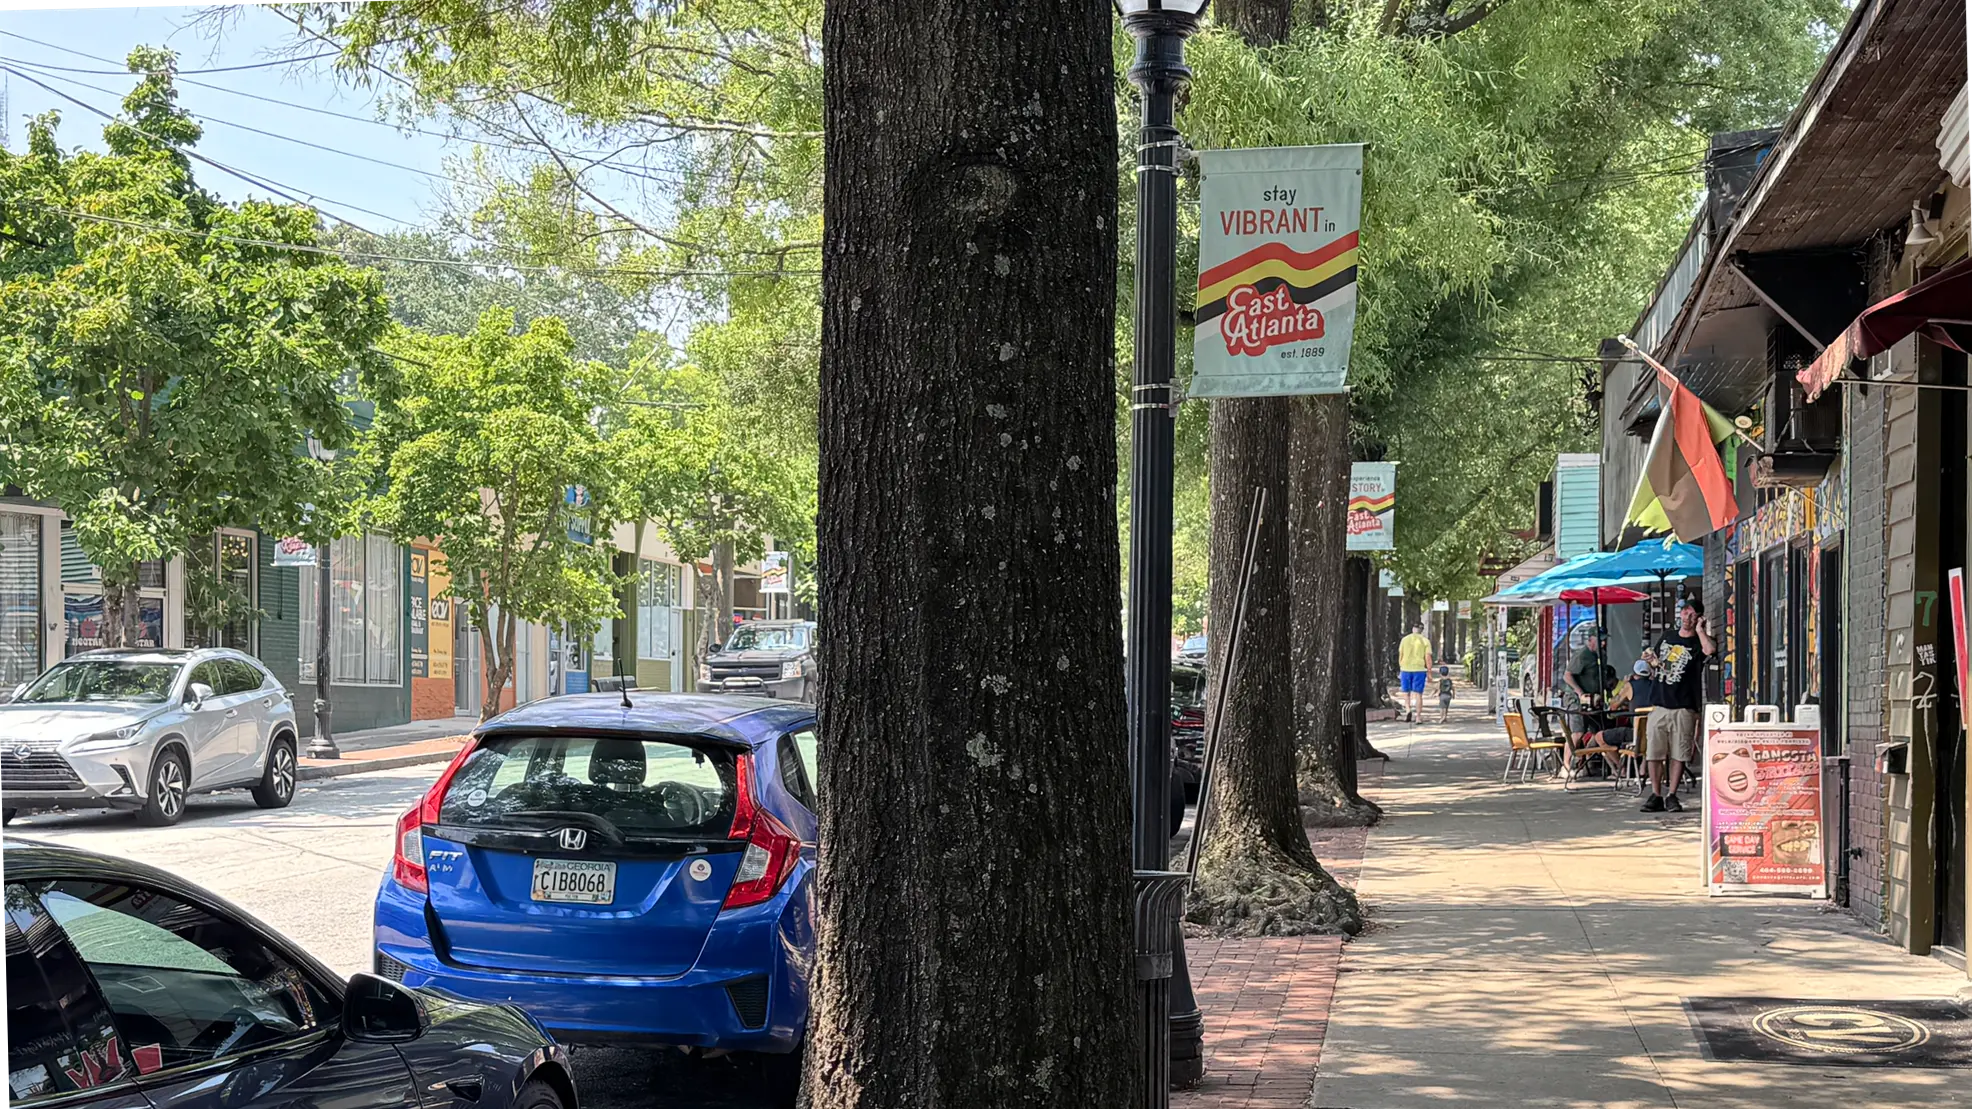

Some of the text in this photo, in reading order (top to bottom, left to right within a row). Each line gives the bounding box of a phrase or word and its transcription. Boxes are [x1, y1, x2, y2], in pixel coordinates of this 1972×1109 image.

[1263, 185, 1297, 206] stay
[1220, 207, 1336, 236] VIBRANT in
[1229, 287, 1289, 318] East
[1223, 307, 1319, 347] Atlanta
[1280, 347, 1325, 359] est. 1889
[1915, 591, 1938, 627] 7
[429, 850, 463, 861] FIT
[566, 861, 611, 872] GEORGIA
[540, 870, 605, 893] CIB8068
